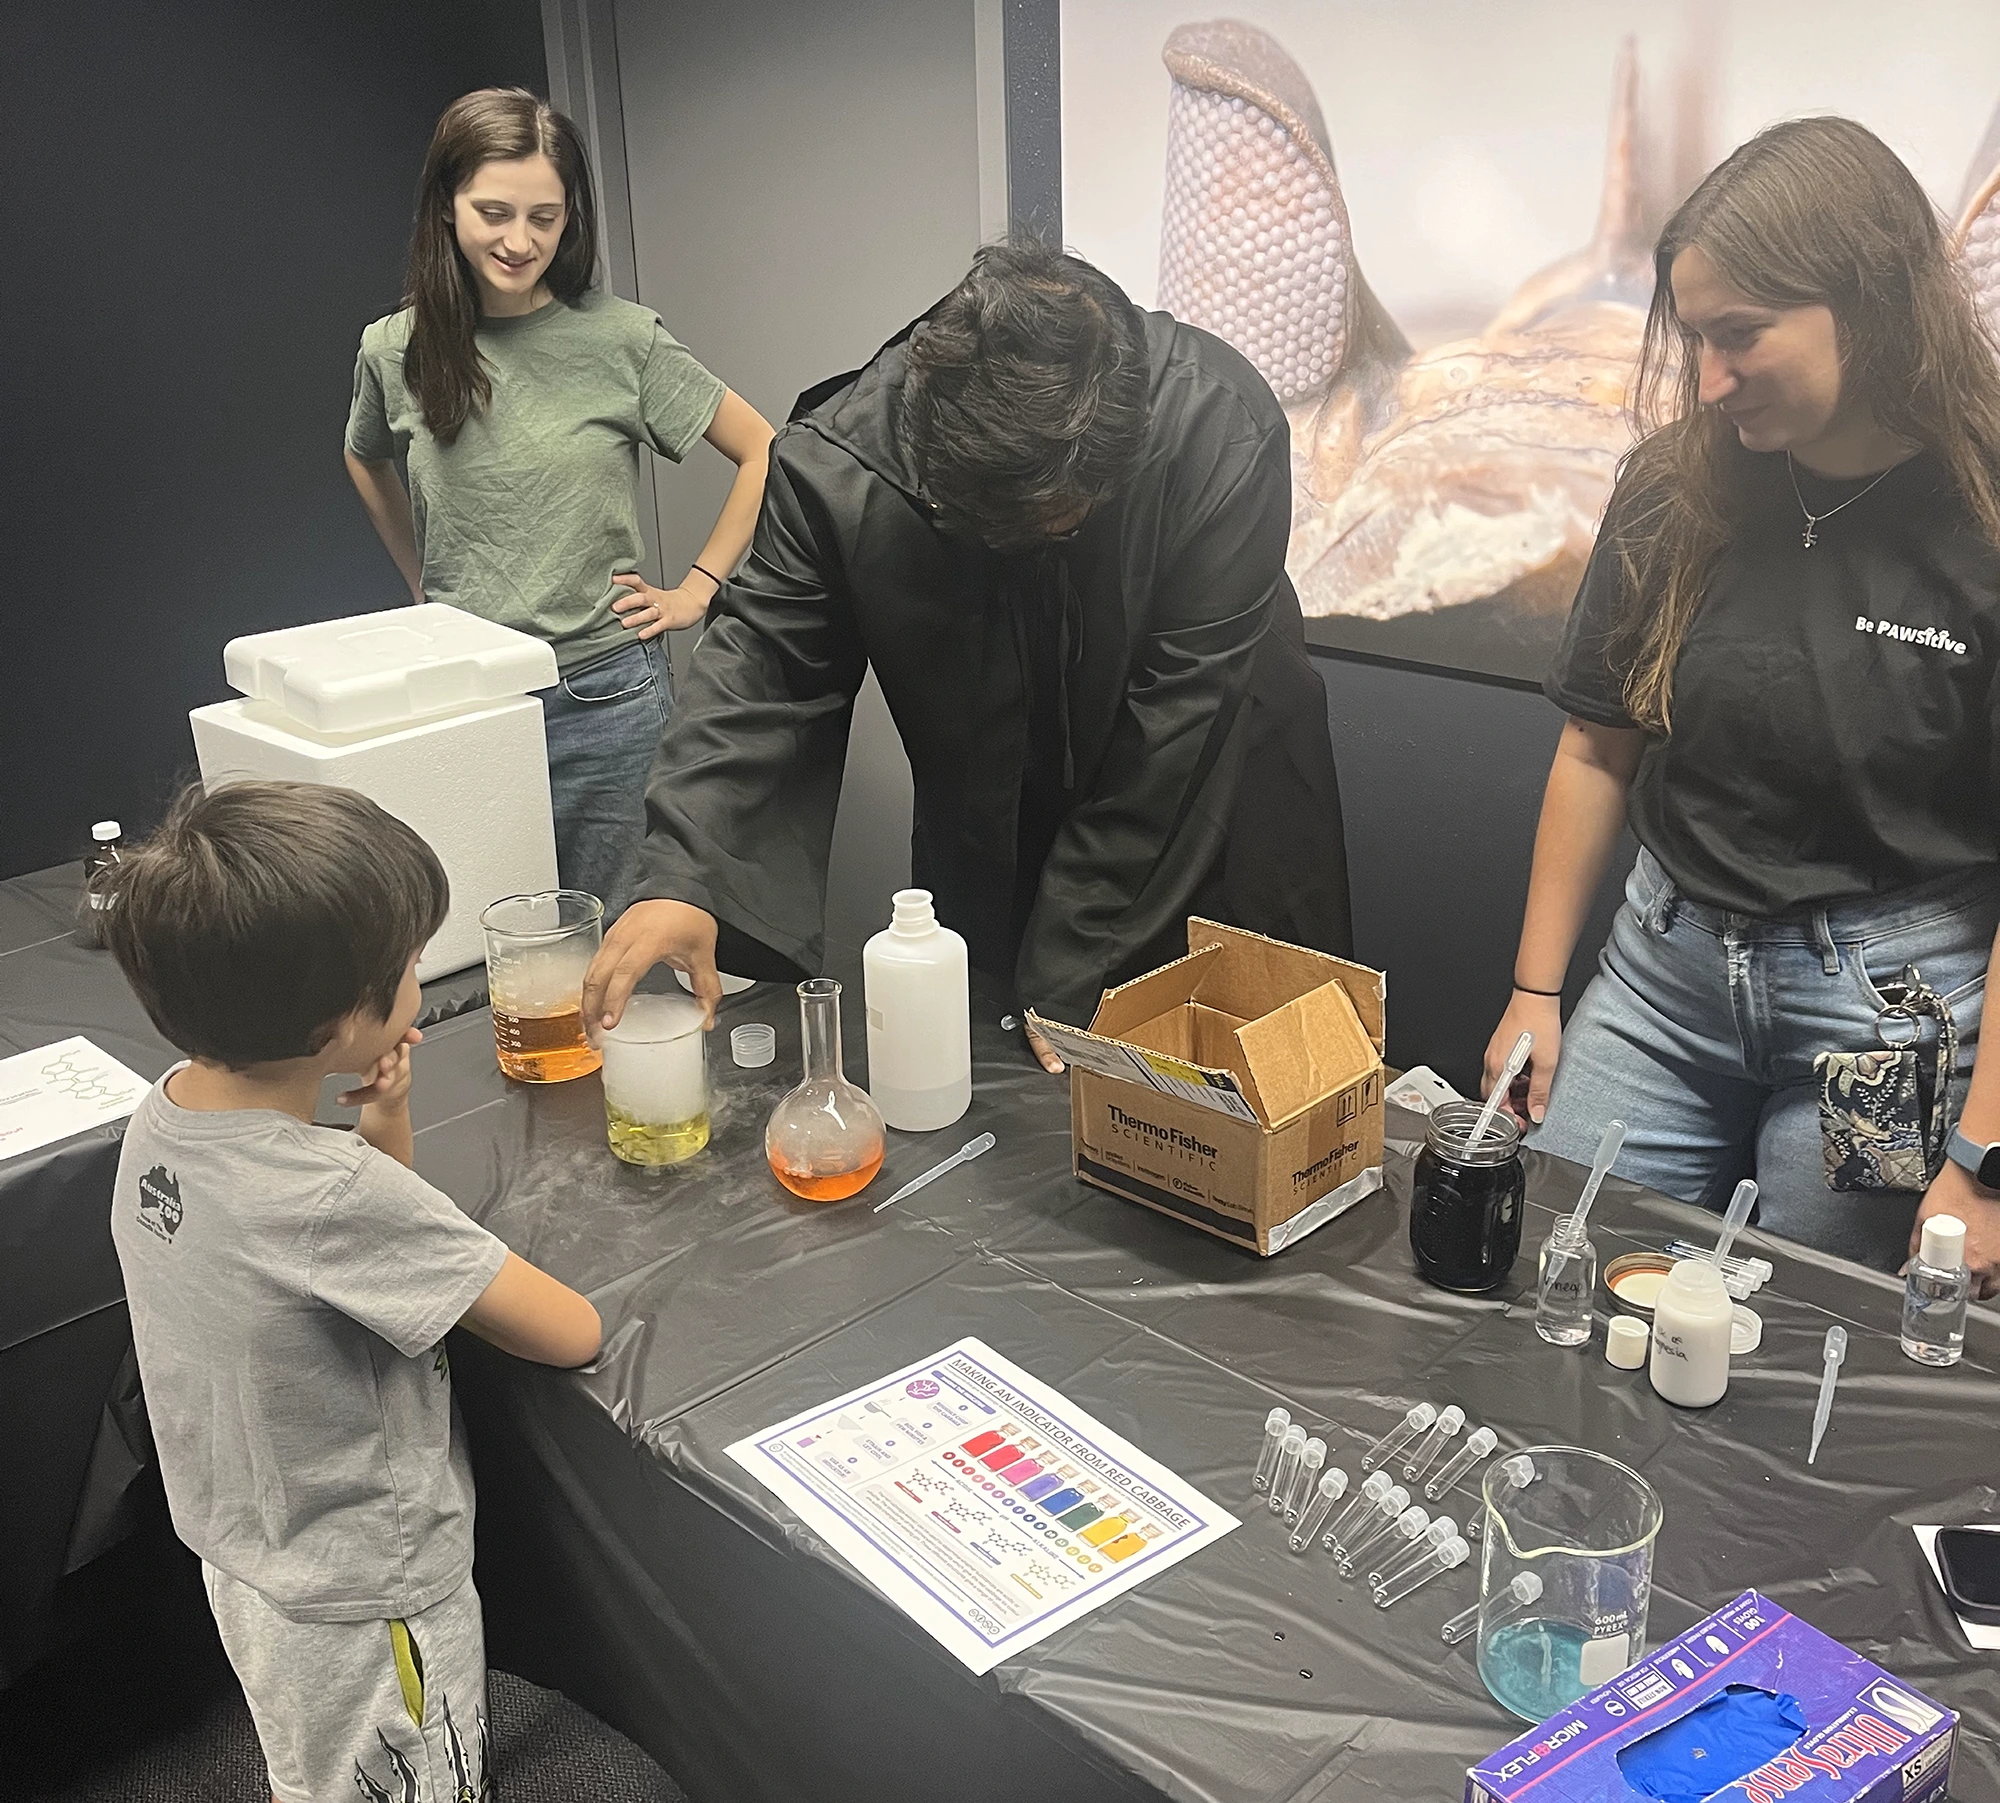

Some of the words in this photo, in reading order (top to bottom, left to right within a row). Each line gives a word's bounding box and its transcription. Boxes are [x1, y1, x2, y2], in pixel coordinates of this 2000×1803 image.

[1855, 616, 1874, 633] Be
[508, 1016, 520, 1024] 500
[509, 1028, 521, 1036] 400
[510, 1040, 522, 1048] 300
[1111, 1124, 1217, 1172] SCIENTIFIC
[1293, 1152, 1357, 1196] SCIENTIFIC
[141, 1178, 182, 1212] Australia
[951, 1359, 997, 1389] MAKING
[992, 1387, 1015, 1402] AN
[1010, 1400, 1075, 1444] INDICATOR
[1070, 1443, 1108, 1469] FROM
[1105, 1468, 1133, 1486] RED
[1129, 1485, 1191, 1527] CABBAGE
[1733, 1607, 1757, 1624] GLOVES
[1744, 1615, 1765, 1630] 100
[1494, 1719, 1589, 1782] MICROFLEX
[1904, 1758, 1922, 1784] XS
